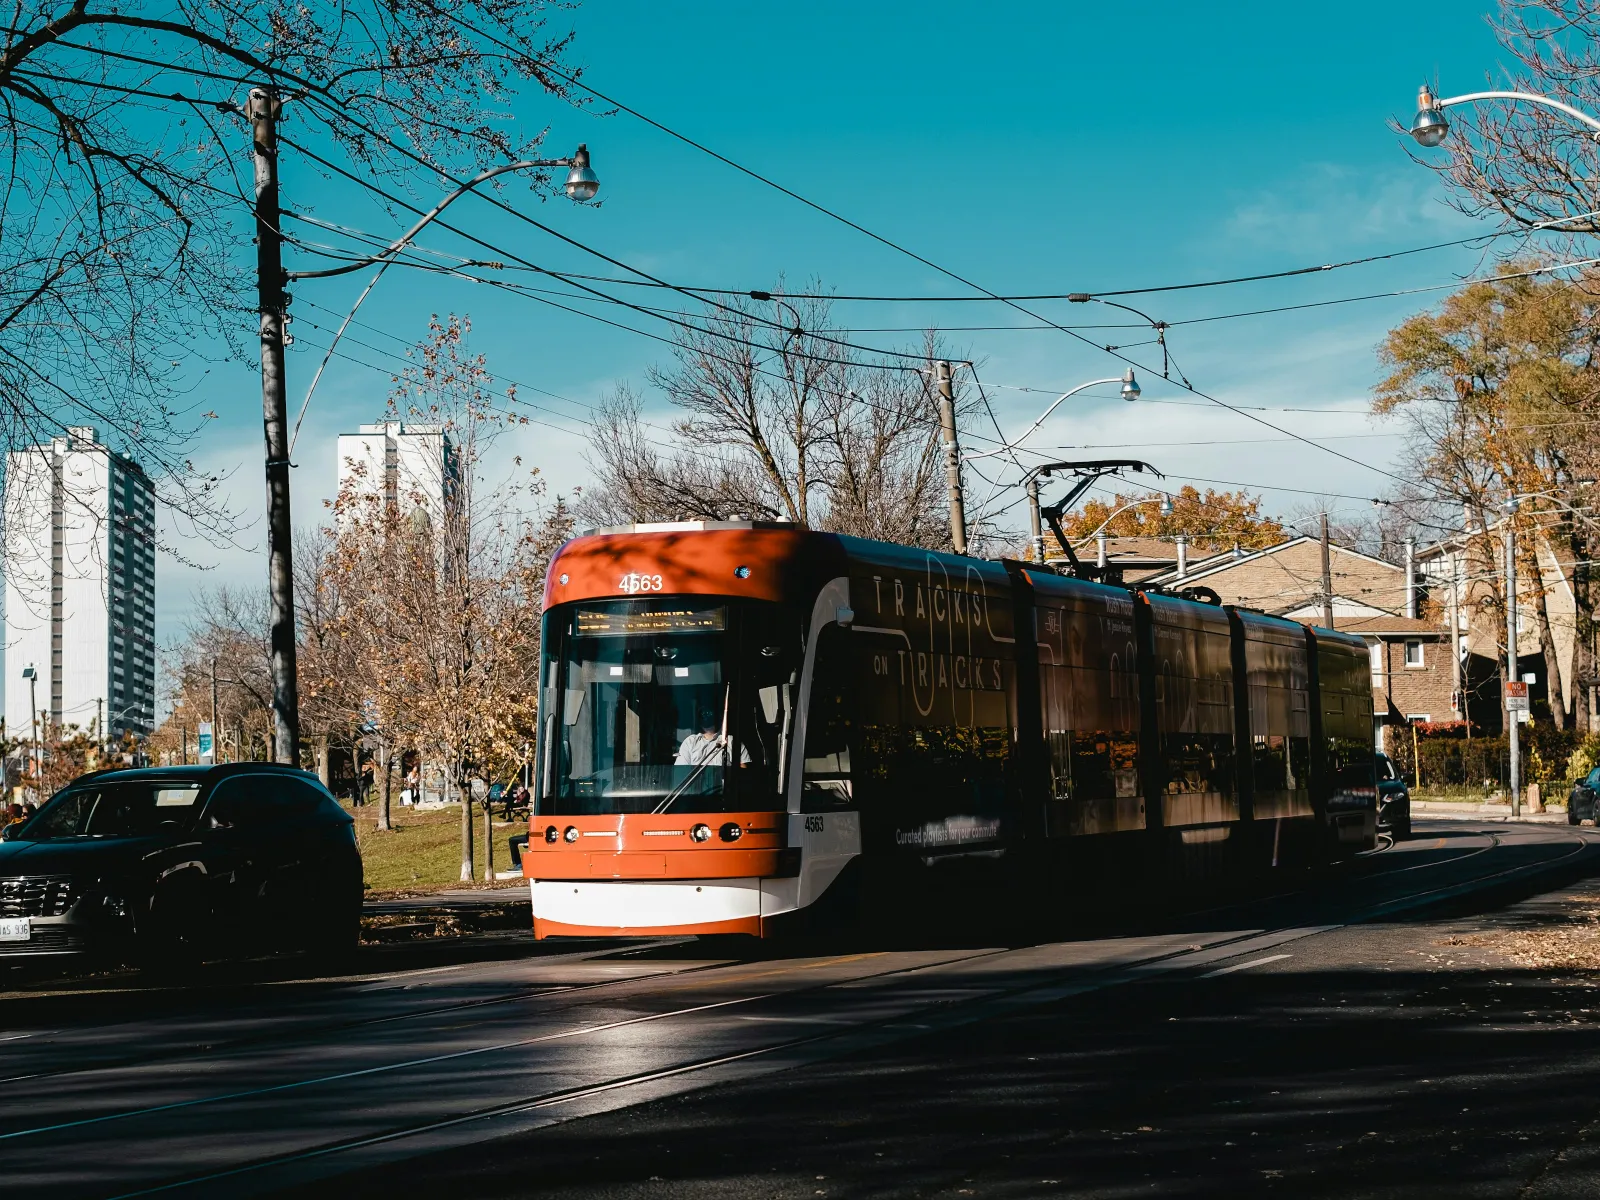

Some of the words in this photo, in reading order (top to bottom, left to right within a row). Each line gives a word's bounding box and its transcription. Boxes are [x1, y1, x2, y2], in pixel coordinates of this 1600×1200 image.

[618, 573, 663, 592] 4563
[873, 575, 981, 627] TRACKS
[873, 655, 888, 675] ON
[898, 650, 1001, 690] TRACKS
[805, 816, 824, 832] 4563
[896, 826, 922, 845] Curated
[923, 825, 948, 847] playlists
[948, 823, 957, 840] for
[956, 828, 972, 845] your
[972, 824, 997, 838] commute
[14, 924, 28, 935] 936
